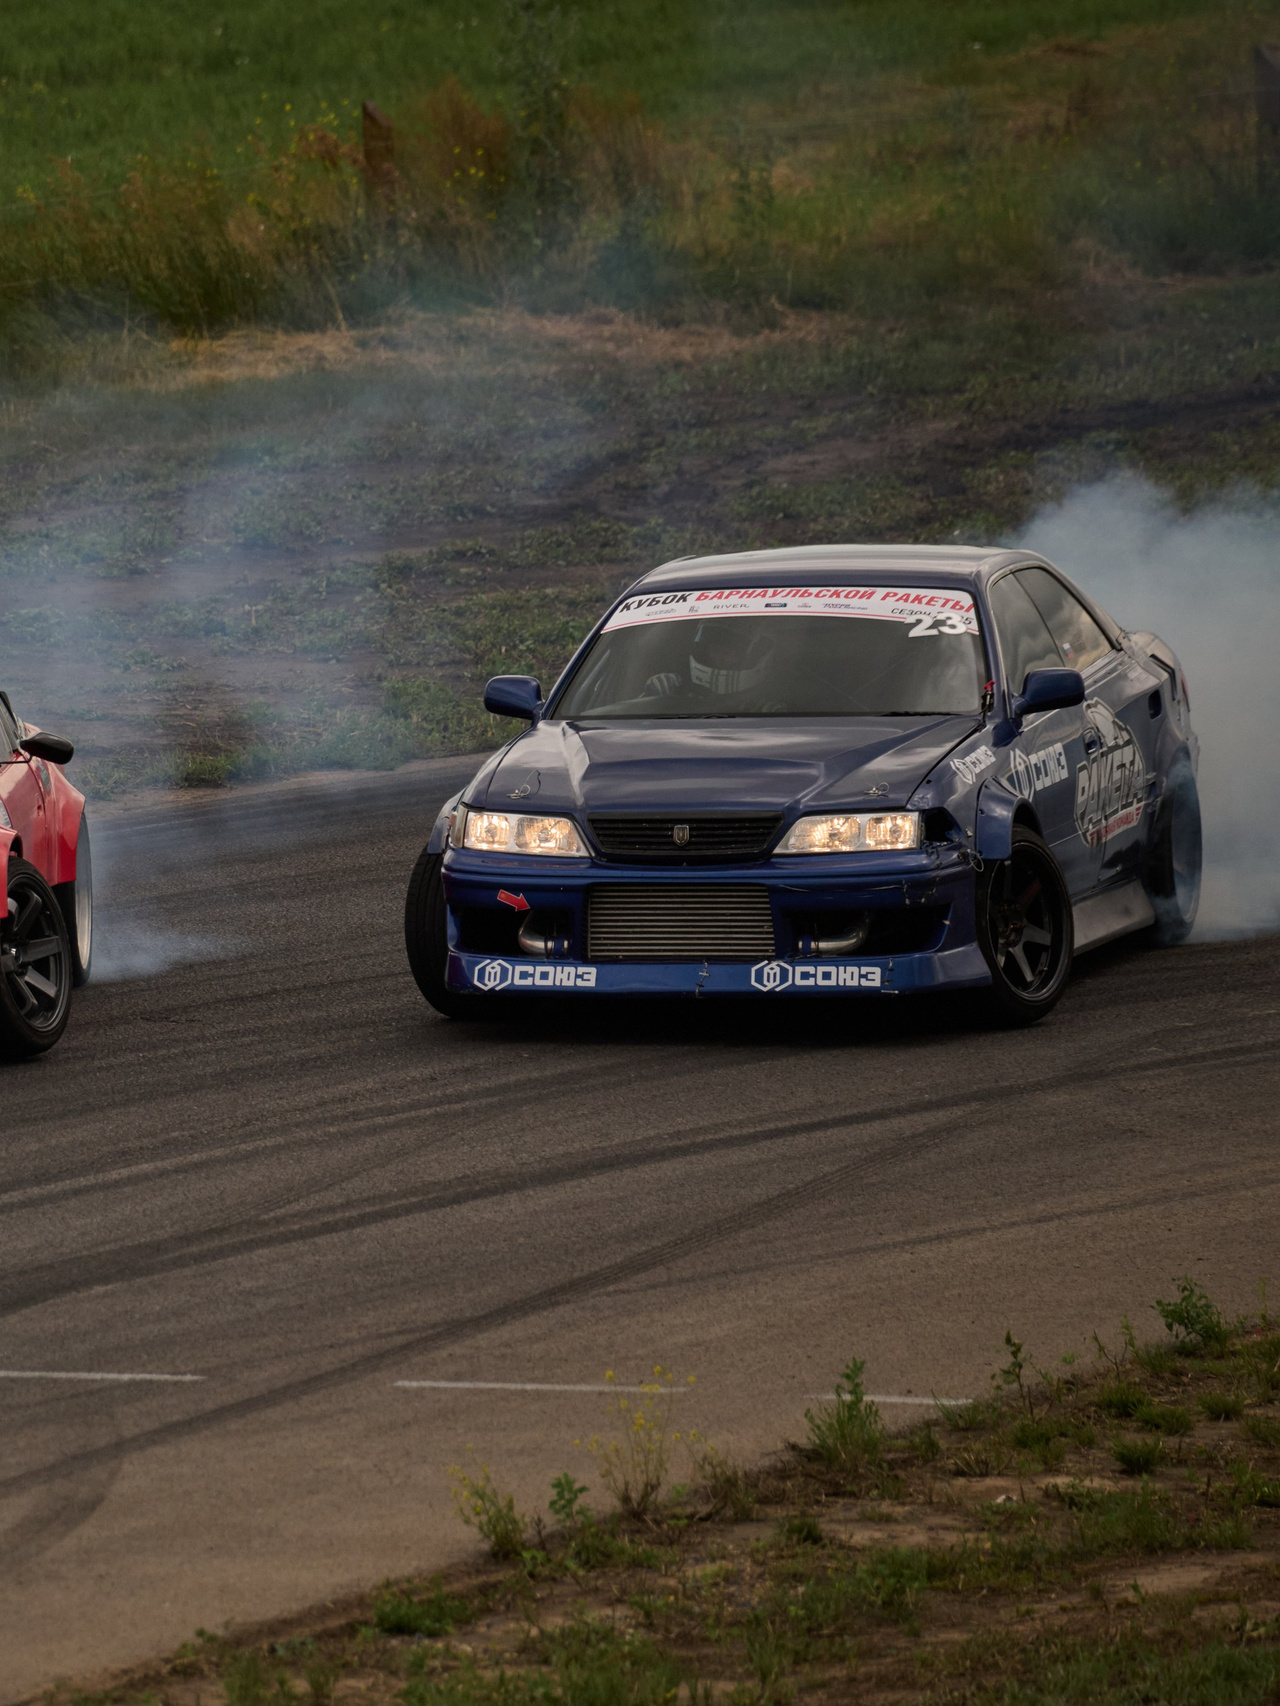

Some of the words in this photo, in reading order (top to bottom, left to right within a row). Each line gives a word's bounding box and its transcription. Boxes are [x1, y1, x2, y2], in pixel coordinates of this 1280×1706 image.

[619, 592, 694, 613] КУБОК
[695, 588, 878, 602] БАРНАУЛЬСКОЙ
[880, 591, 975, 613] РАКЕТЫ
[904, 612, 968, 638] 23
[513, 966, 596, 987] СОЮЗ
[794, 965, 881, 987] СОЮЗ
